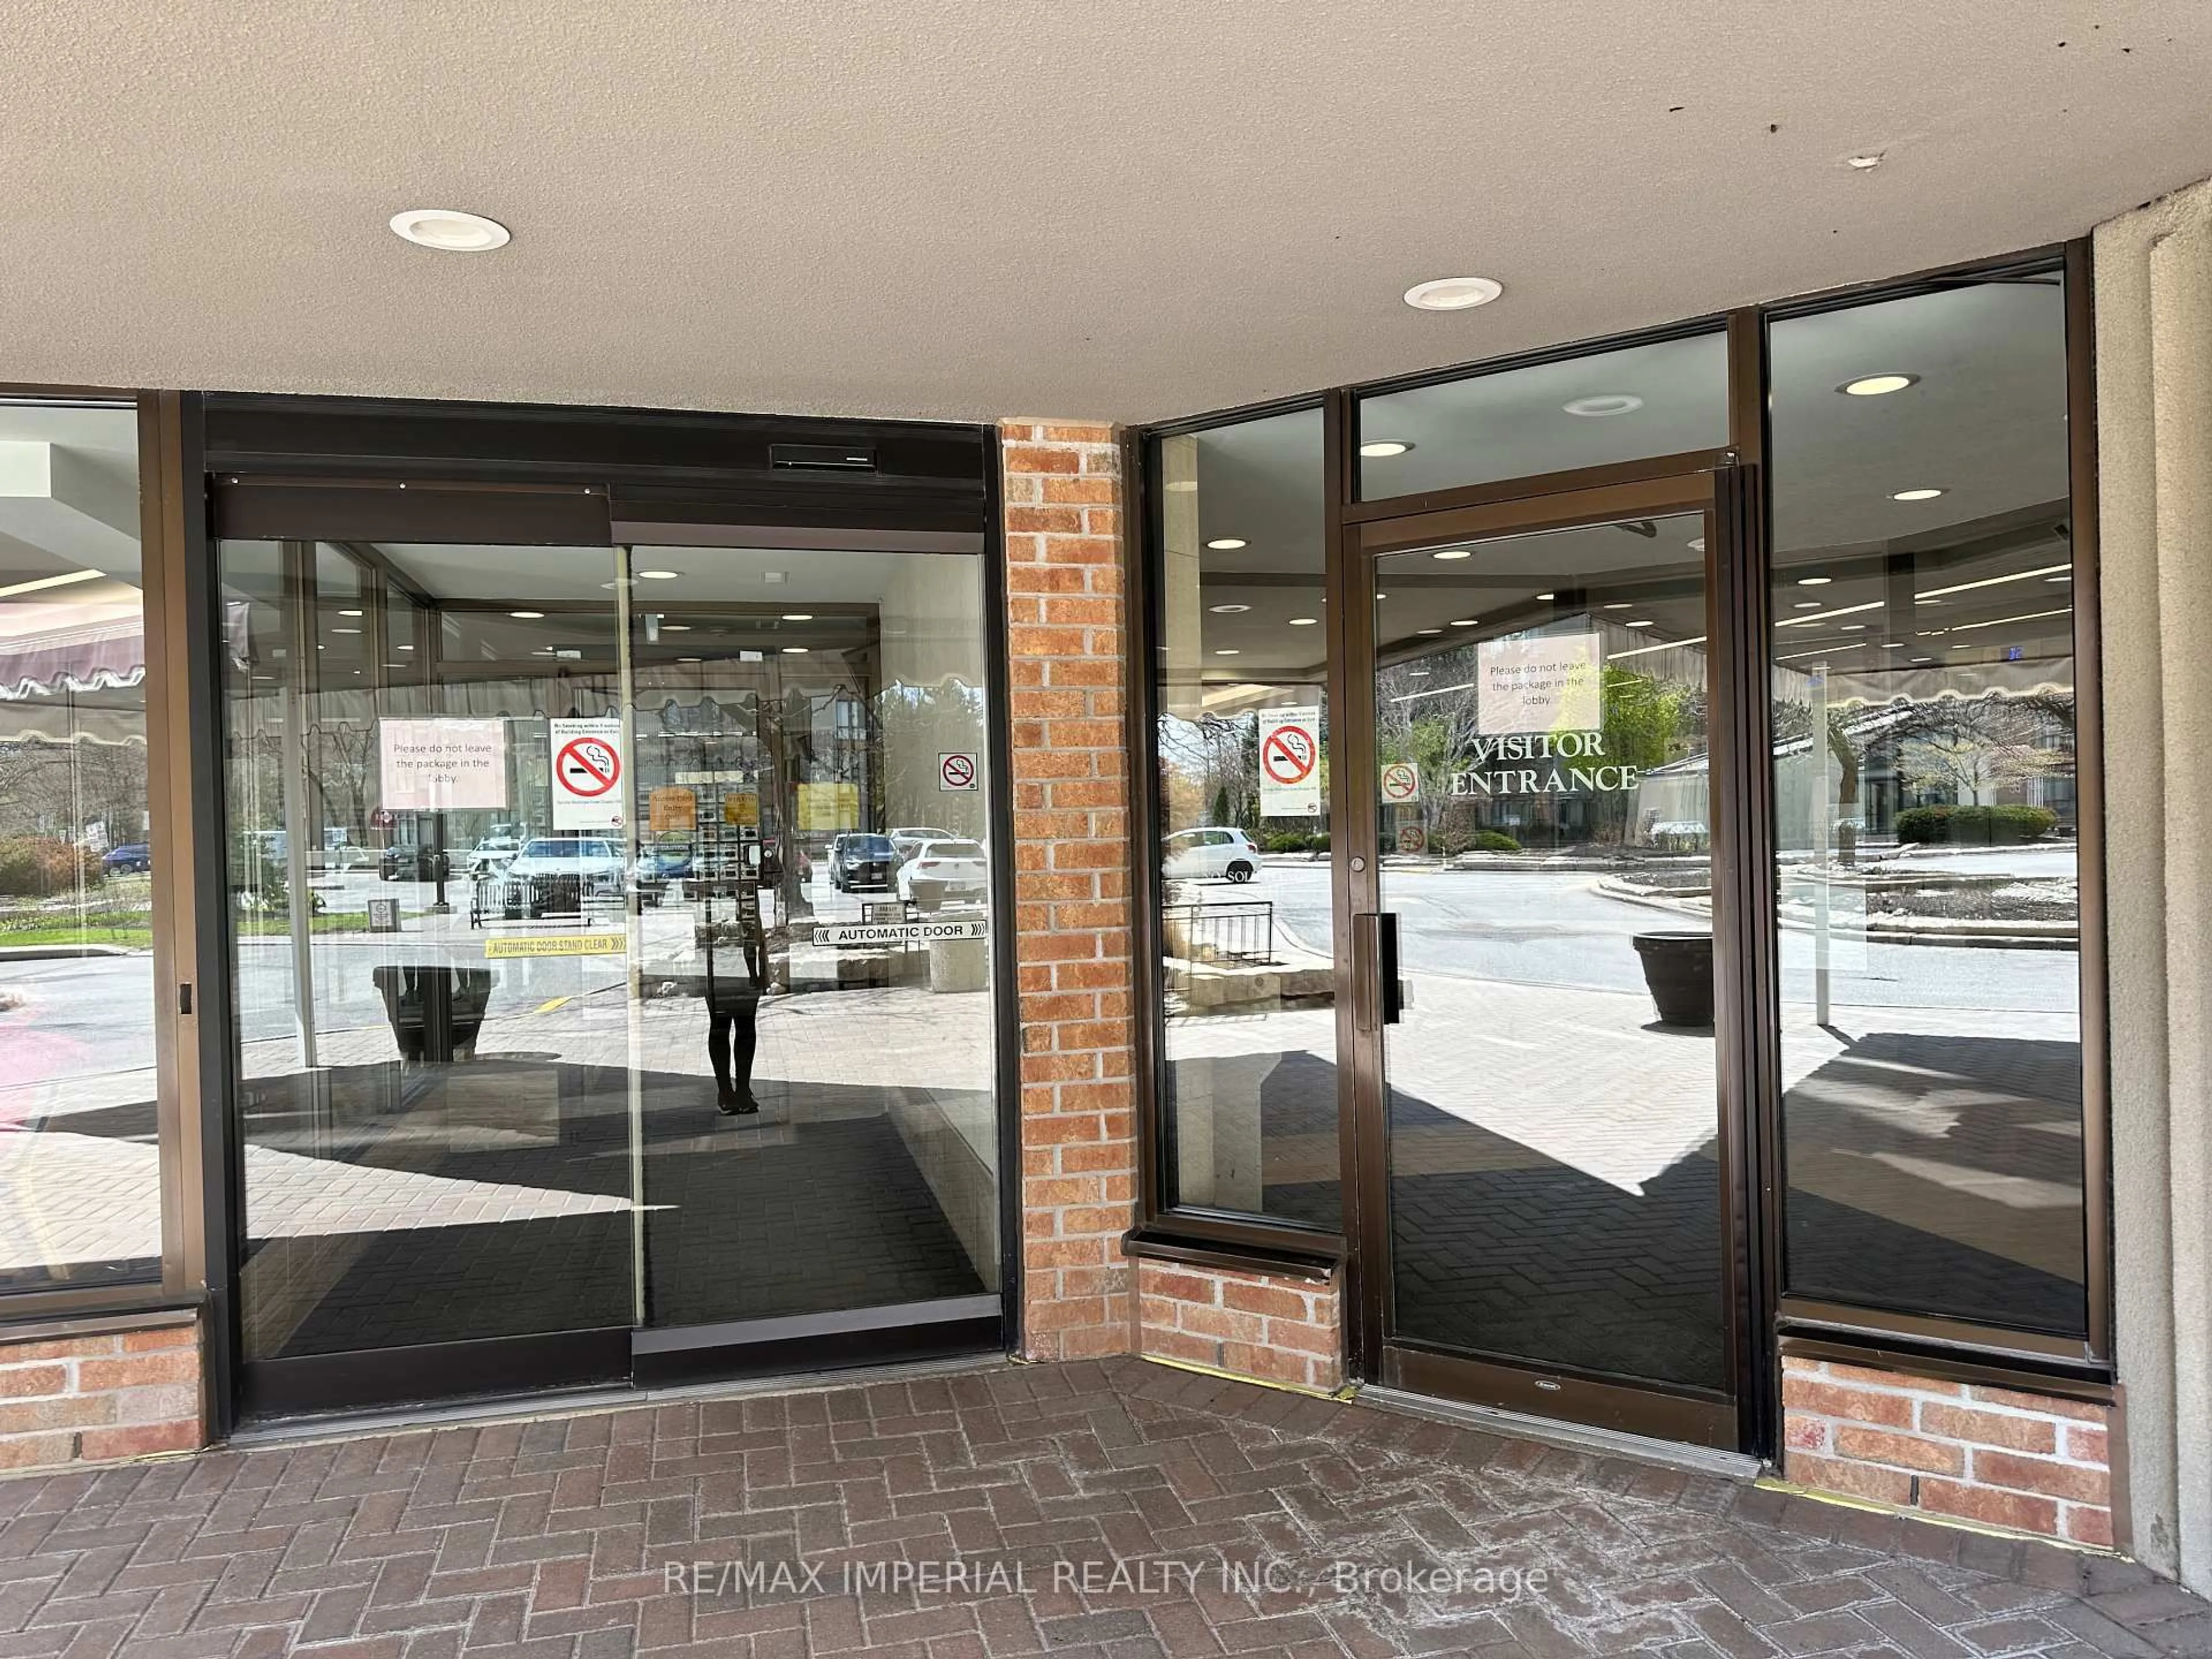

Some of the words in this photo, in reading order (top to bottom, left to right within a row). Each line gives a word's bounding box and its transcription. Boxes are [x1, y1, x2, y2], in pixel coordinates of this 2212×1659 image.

[1490, 665, 1521, 676] Please
[1524, 664, 1536, 673] do
[1540, 664, 1556, 672] not
[1560, 661, 1586, 671] leave
[1493, 682, 1509, 691] the
[1512, 680, 1552, 692] package
[1556, 679, 1563, 687] in
[1567, 677, 1584, 686] the
[1523, 696, 1550, 706] lobby
[394, 744, 426, 753] Please
[430, 744, 442, 752] do
[465, 744, 491, 752] leave
[1471, 732, 1605, 762] VISITOR
[396, 759, 413, 768] the
[417, 759, 457, 770] package
[461, 759, 469, 767] in
[473, 758, 489, 767] the
[1450, 765, 1639, 796] ENTRANCE
[839, 927, 919, 940] AUTOMATIC
[923, 926, 963, 937] DOOR
[493, 941, 535, 953] AUTOMATIC
[559, 940, 582, 951] STAND
[584, 939, 607, 950] CLEAR
